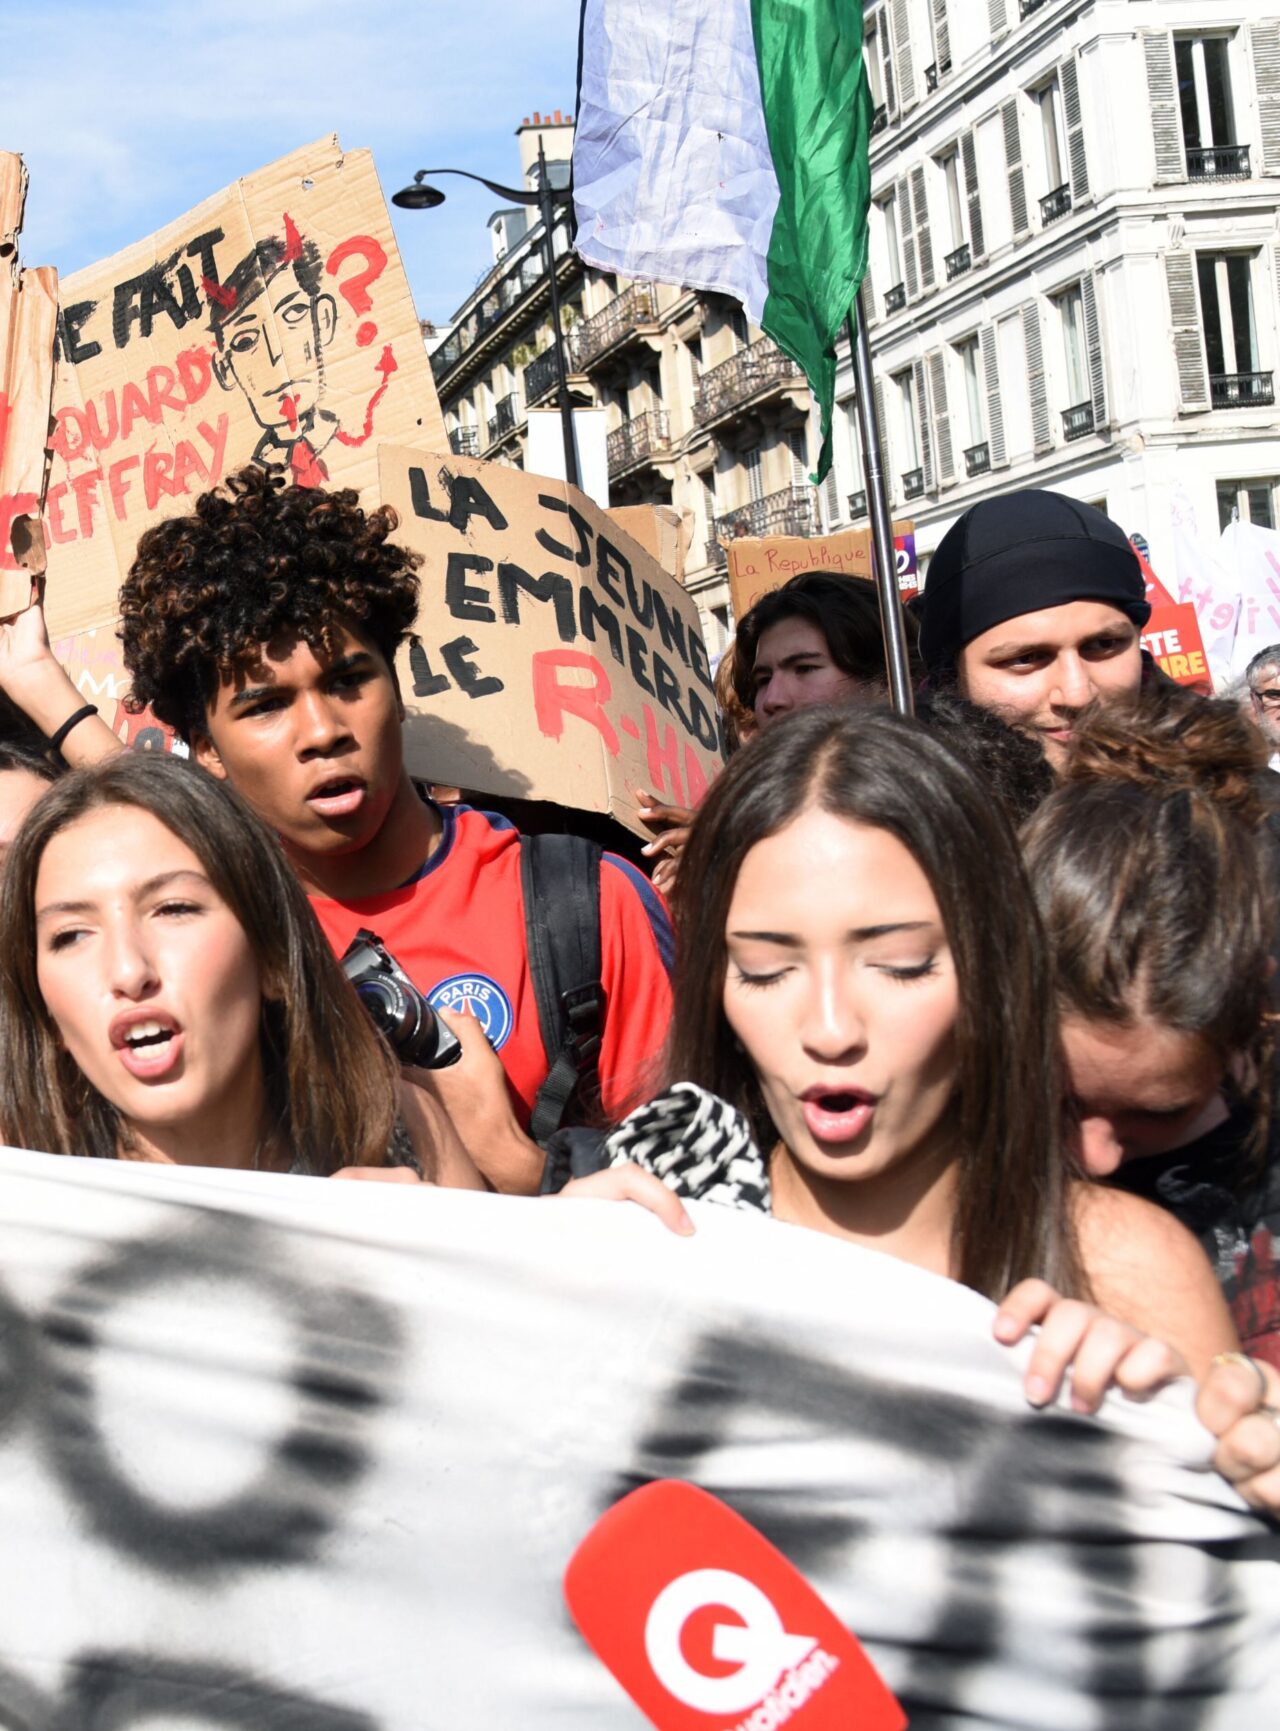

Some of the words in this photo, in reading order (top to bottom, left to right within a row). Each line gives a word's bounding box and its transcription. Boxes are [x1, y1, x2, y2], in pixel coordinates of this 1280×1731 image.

[112, 227, 225, 349] FAIT
[42, 414, 228, 549] EFFRAY
[408, 466, 508, 531] LA
[733, 550, 761, 578] La
[409, 635, 504, 698] LE
[439, 982, 492, 1005] PARIS
